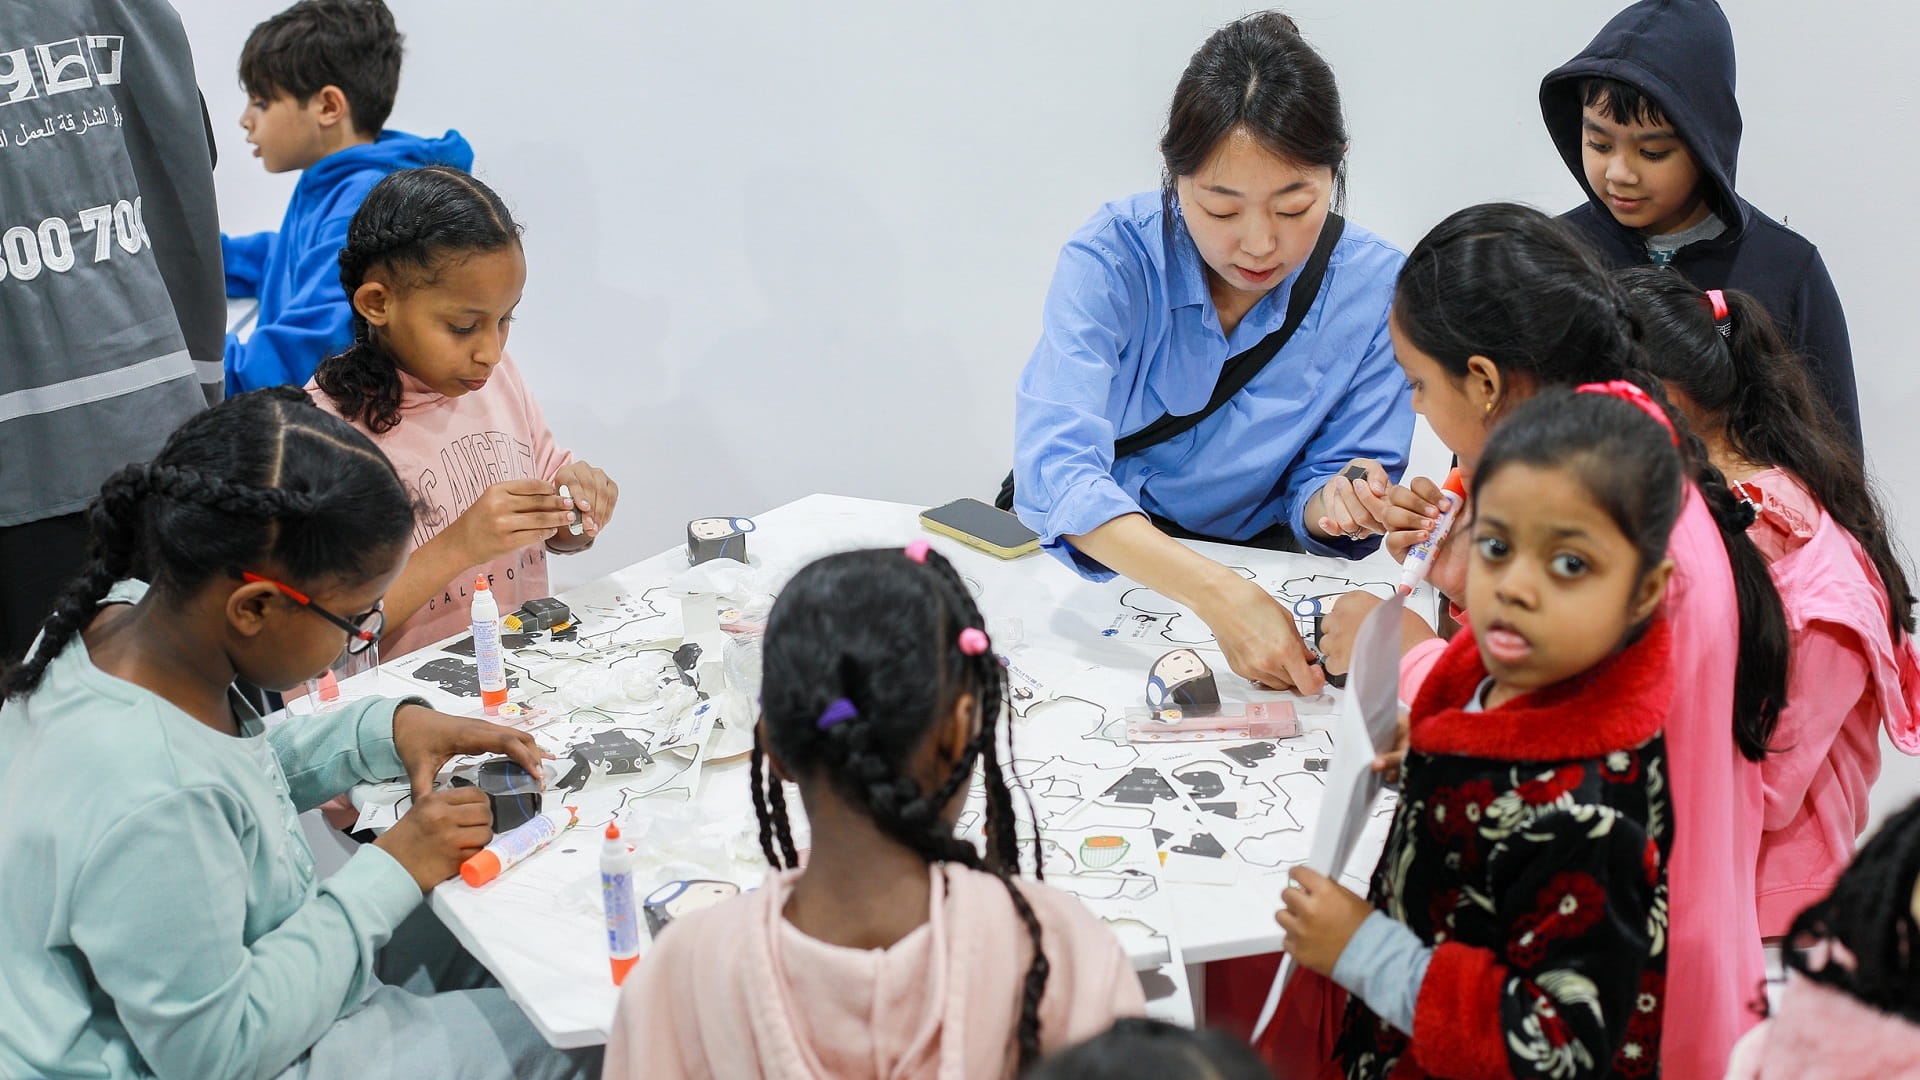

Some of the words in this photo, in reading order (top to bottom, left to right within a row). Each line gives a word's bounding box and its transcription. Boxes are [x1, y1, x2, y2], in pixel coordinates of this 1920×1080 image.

[0, 35, 124, 106] تطو
[15, 117, 55, 146] للعمل
[57, 107, 108, 134] الشارقة
